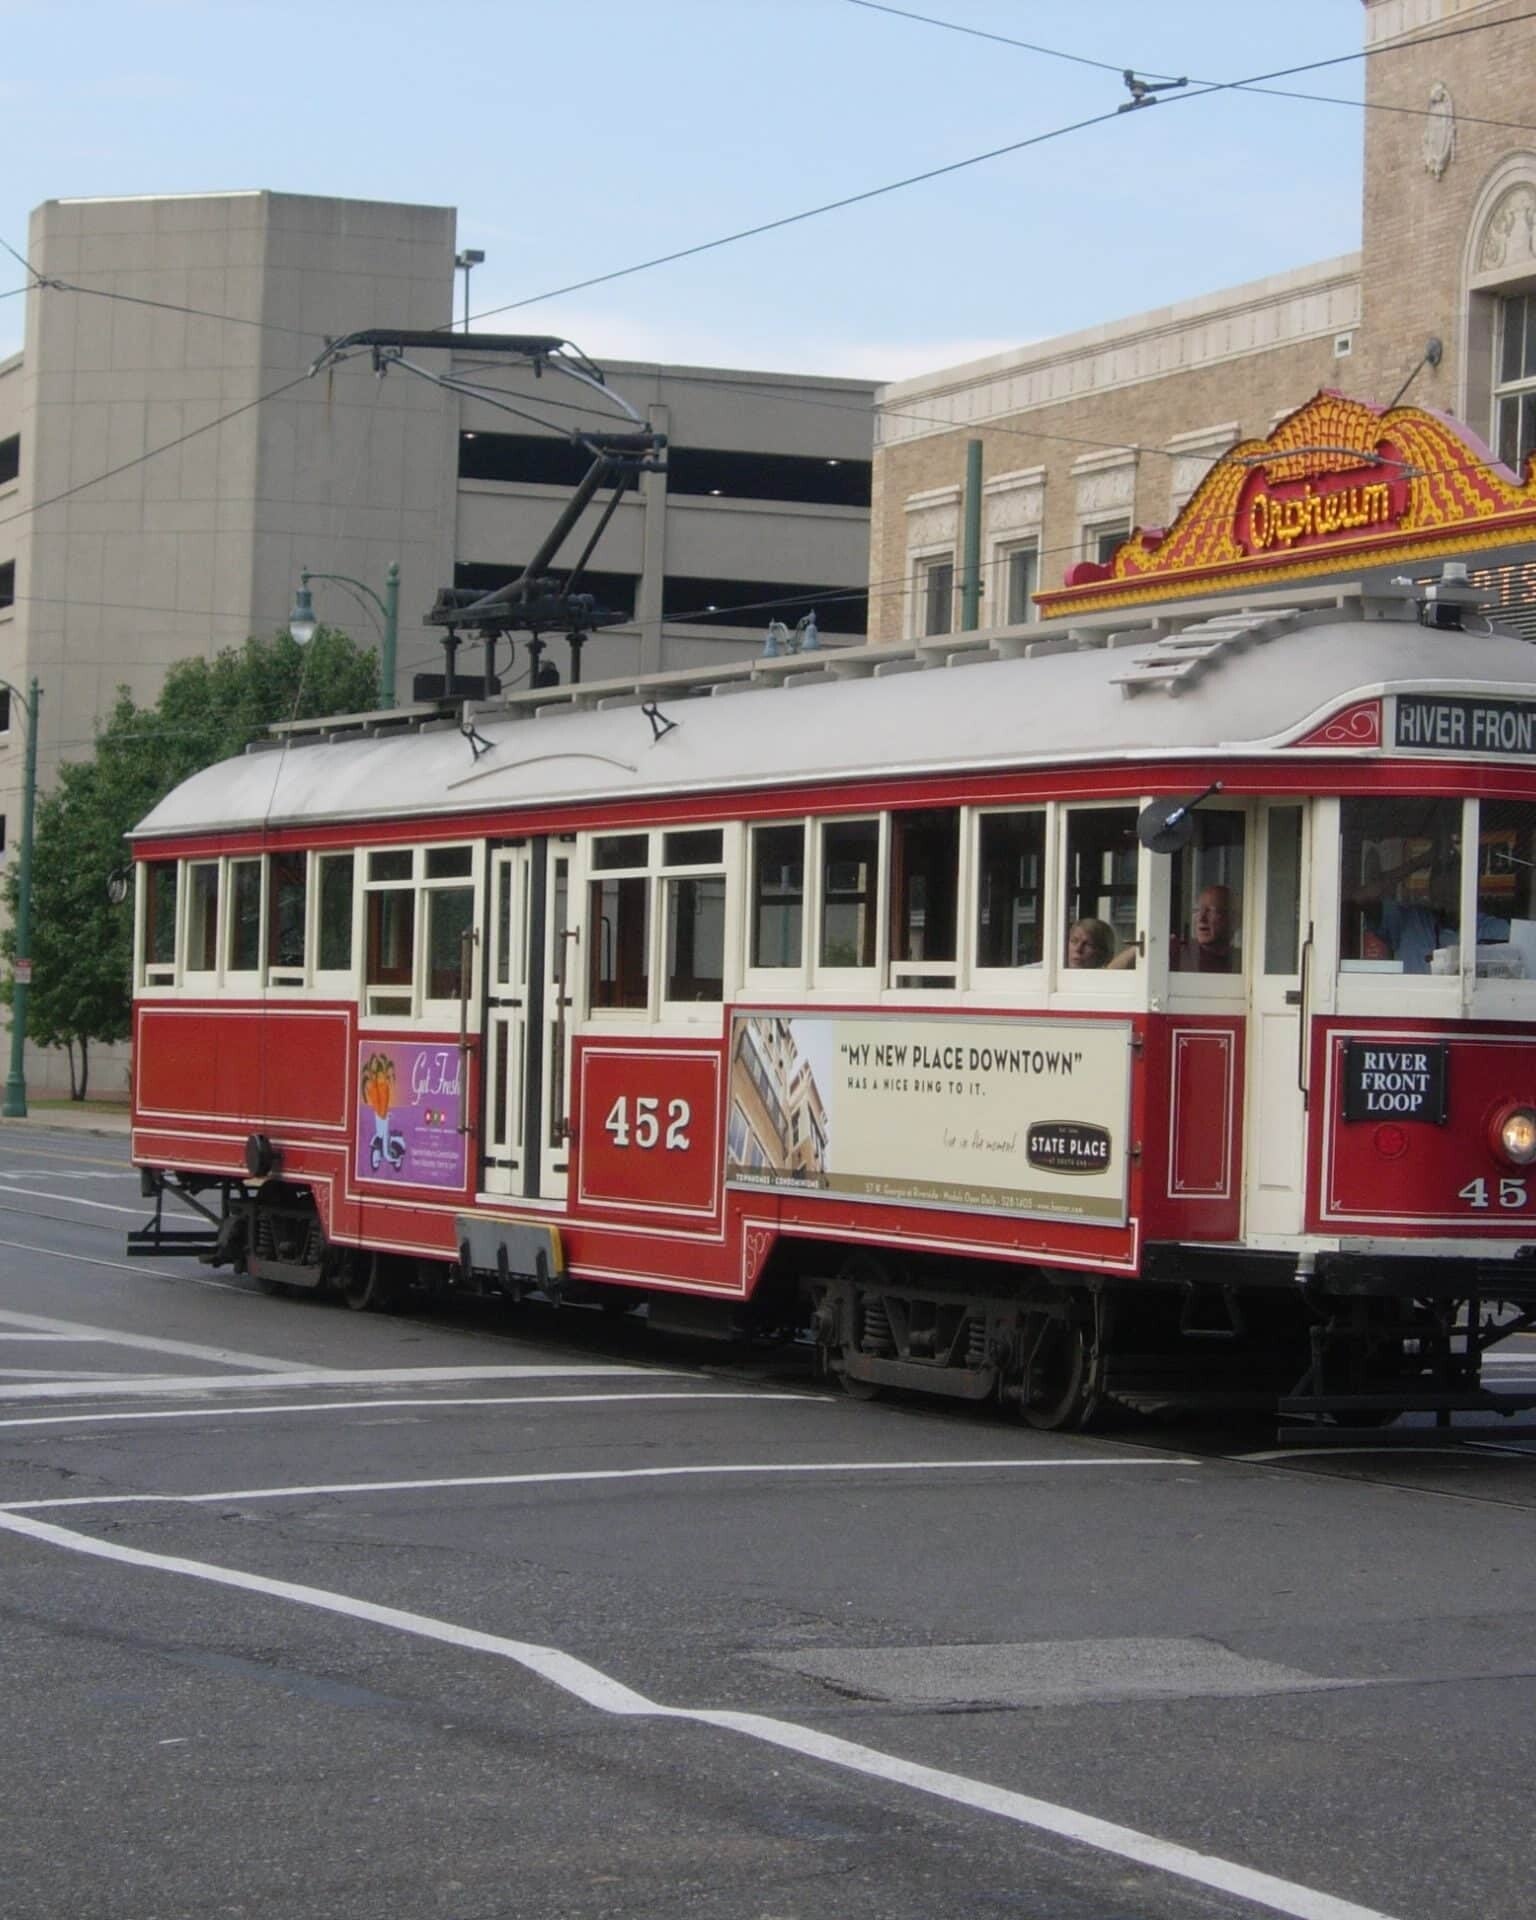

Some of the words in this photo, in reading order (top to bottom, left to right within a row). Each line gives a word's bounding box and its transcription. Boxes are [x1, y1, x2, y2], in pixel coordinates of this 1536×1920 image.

[1251, 482, 1389, 549] Orpheum
[1400, 704, 1466, 745] RIVER
[1472, 709, 1536, 750] FRON
[875, 1044, 908, 1067] NEW
[912, 1045, 964, 1070] PLACE
[1363, 1051, 1428, 1071] RIVER
[847, 1076, 868, 1090] HAS
[872, 1079, 878, 1090] A
[882, 1078, 908, 1092] NICE
[914, 1080, 942, 1094] RING
[948, 1081, 964, 1095] TO
[969, 1082, 986, 1097] IT.
[1360, 1071, 1430, 1092] FRONT
[1367, 1092, 1423, 1112] LOOP
[605, 1095, 691, 1150] 452
[1031, 1136, 1066, 1154] STATE
[1069, 1139, 1108, 1157] PLACE
